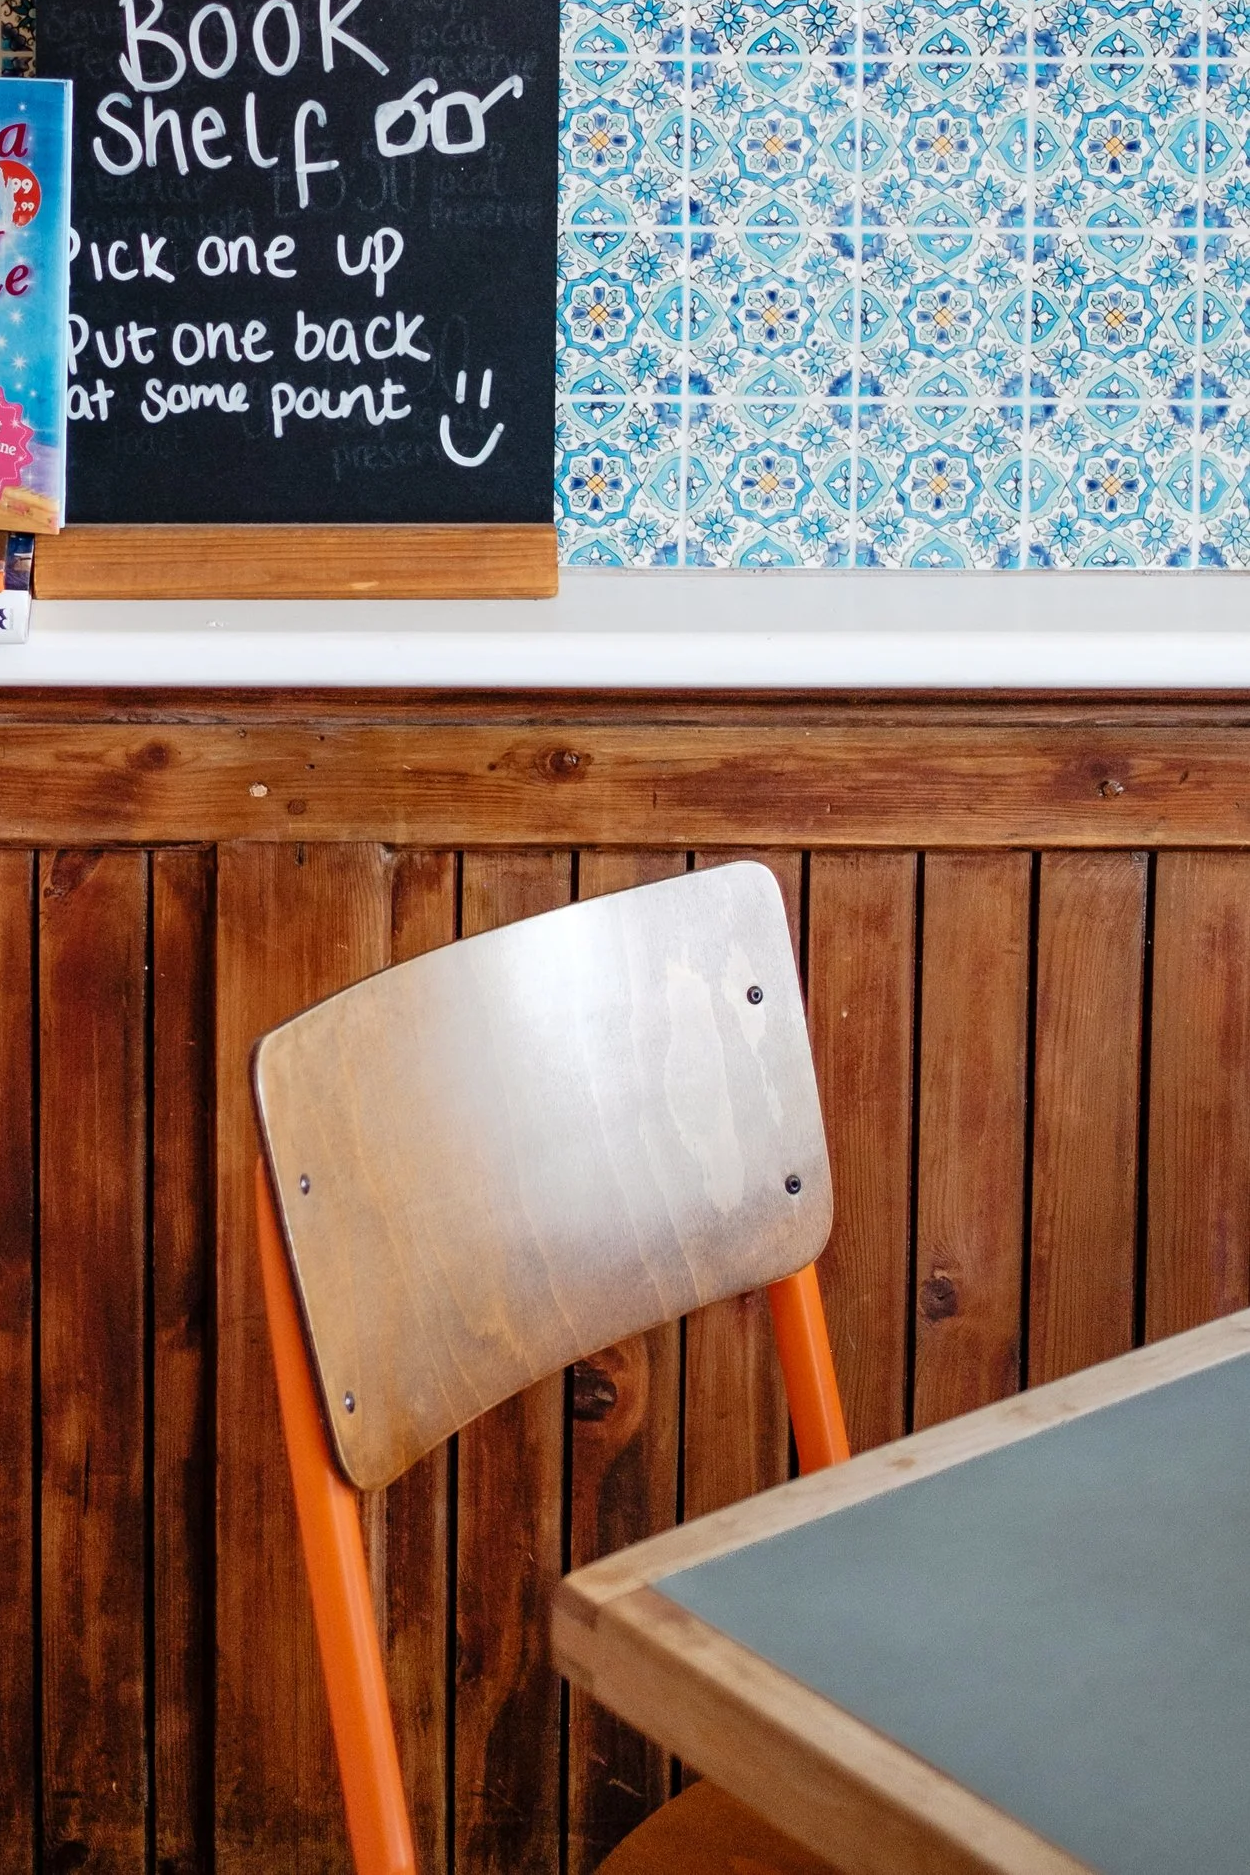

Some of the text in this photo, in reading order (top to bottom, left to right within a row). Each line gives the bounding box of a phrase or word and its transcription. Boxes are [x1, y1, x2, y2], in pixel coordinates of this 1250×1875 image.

[93, 91, 340, 209] Shelf
[197, 234, 297, 279] one
[337, 226, 404, 298] up
[69, 310, 431, 375] Put one back
[69, 379, 114, 422] at
[140, 377, 249, 424] some
